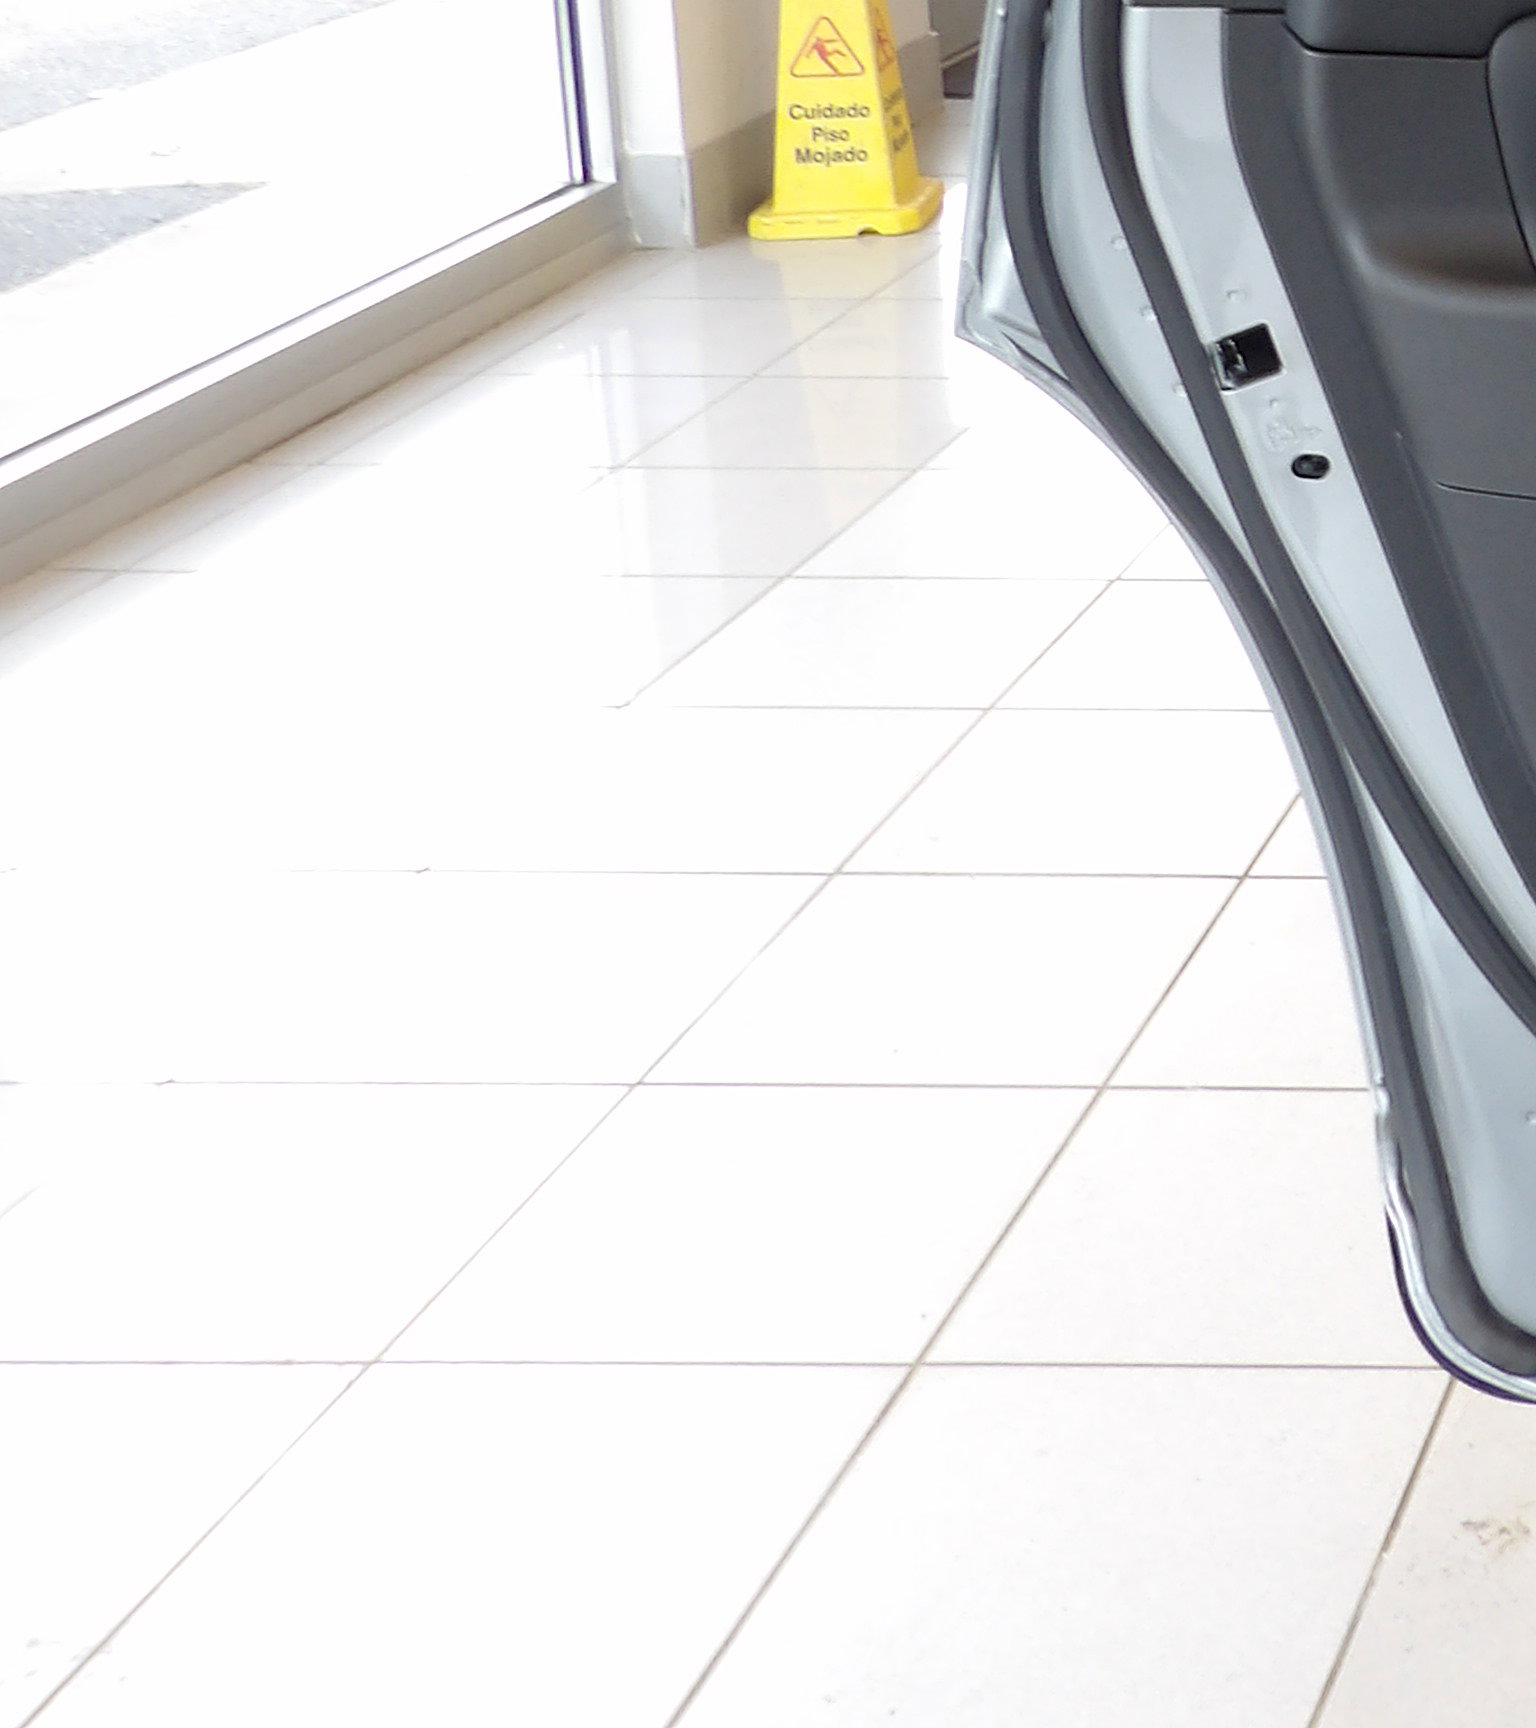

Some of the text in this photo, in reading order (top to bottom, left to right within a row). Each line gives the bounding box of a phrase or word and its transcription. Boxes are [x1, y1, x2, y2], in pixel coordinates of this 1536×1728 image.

[789, 104, 870, 120] Cuidado
[812, 127, 850, 142] Piso
[795, 148, 868, 167] Mojado
